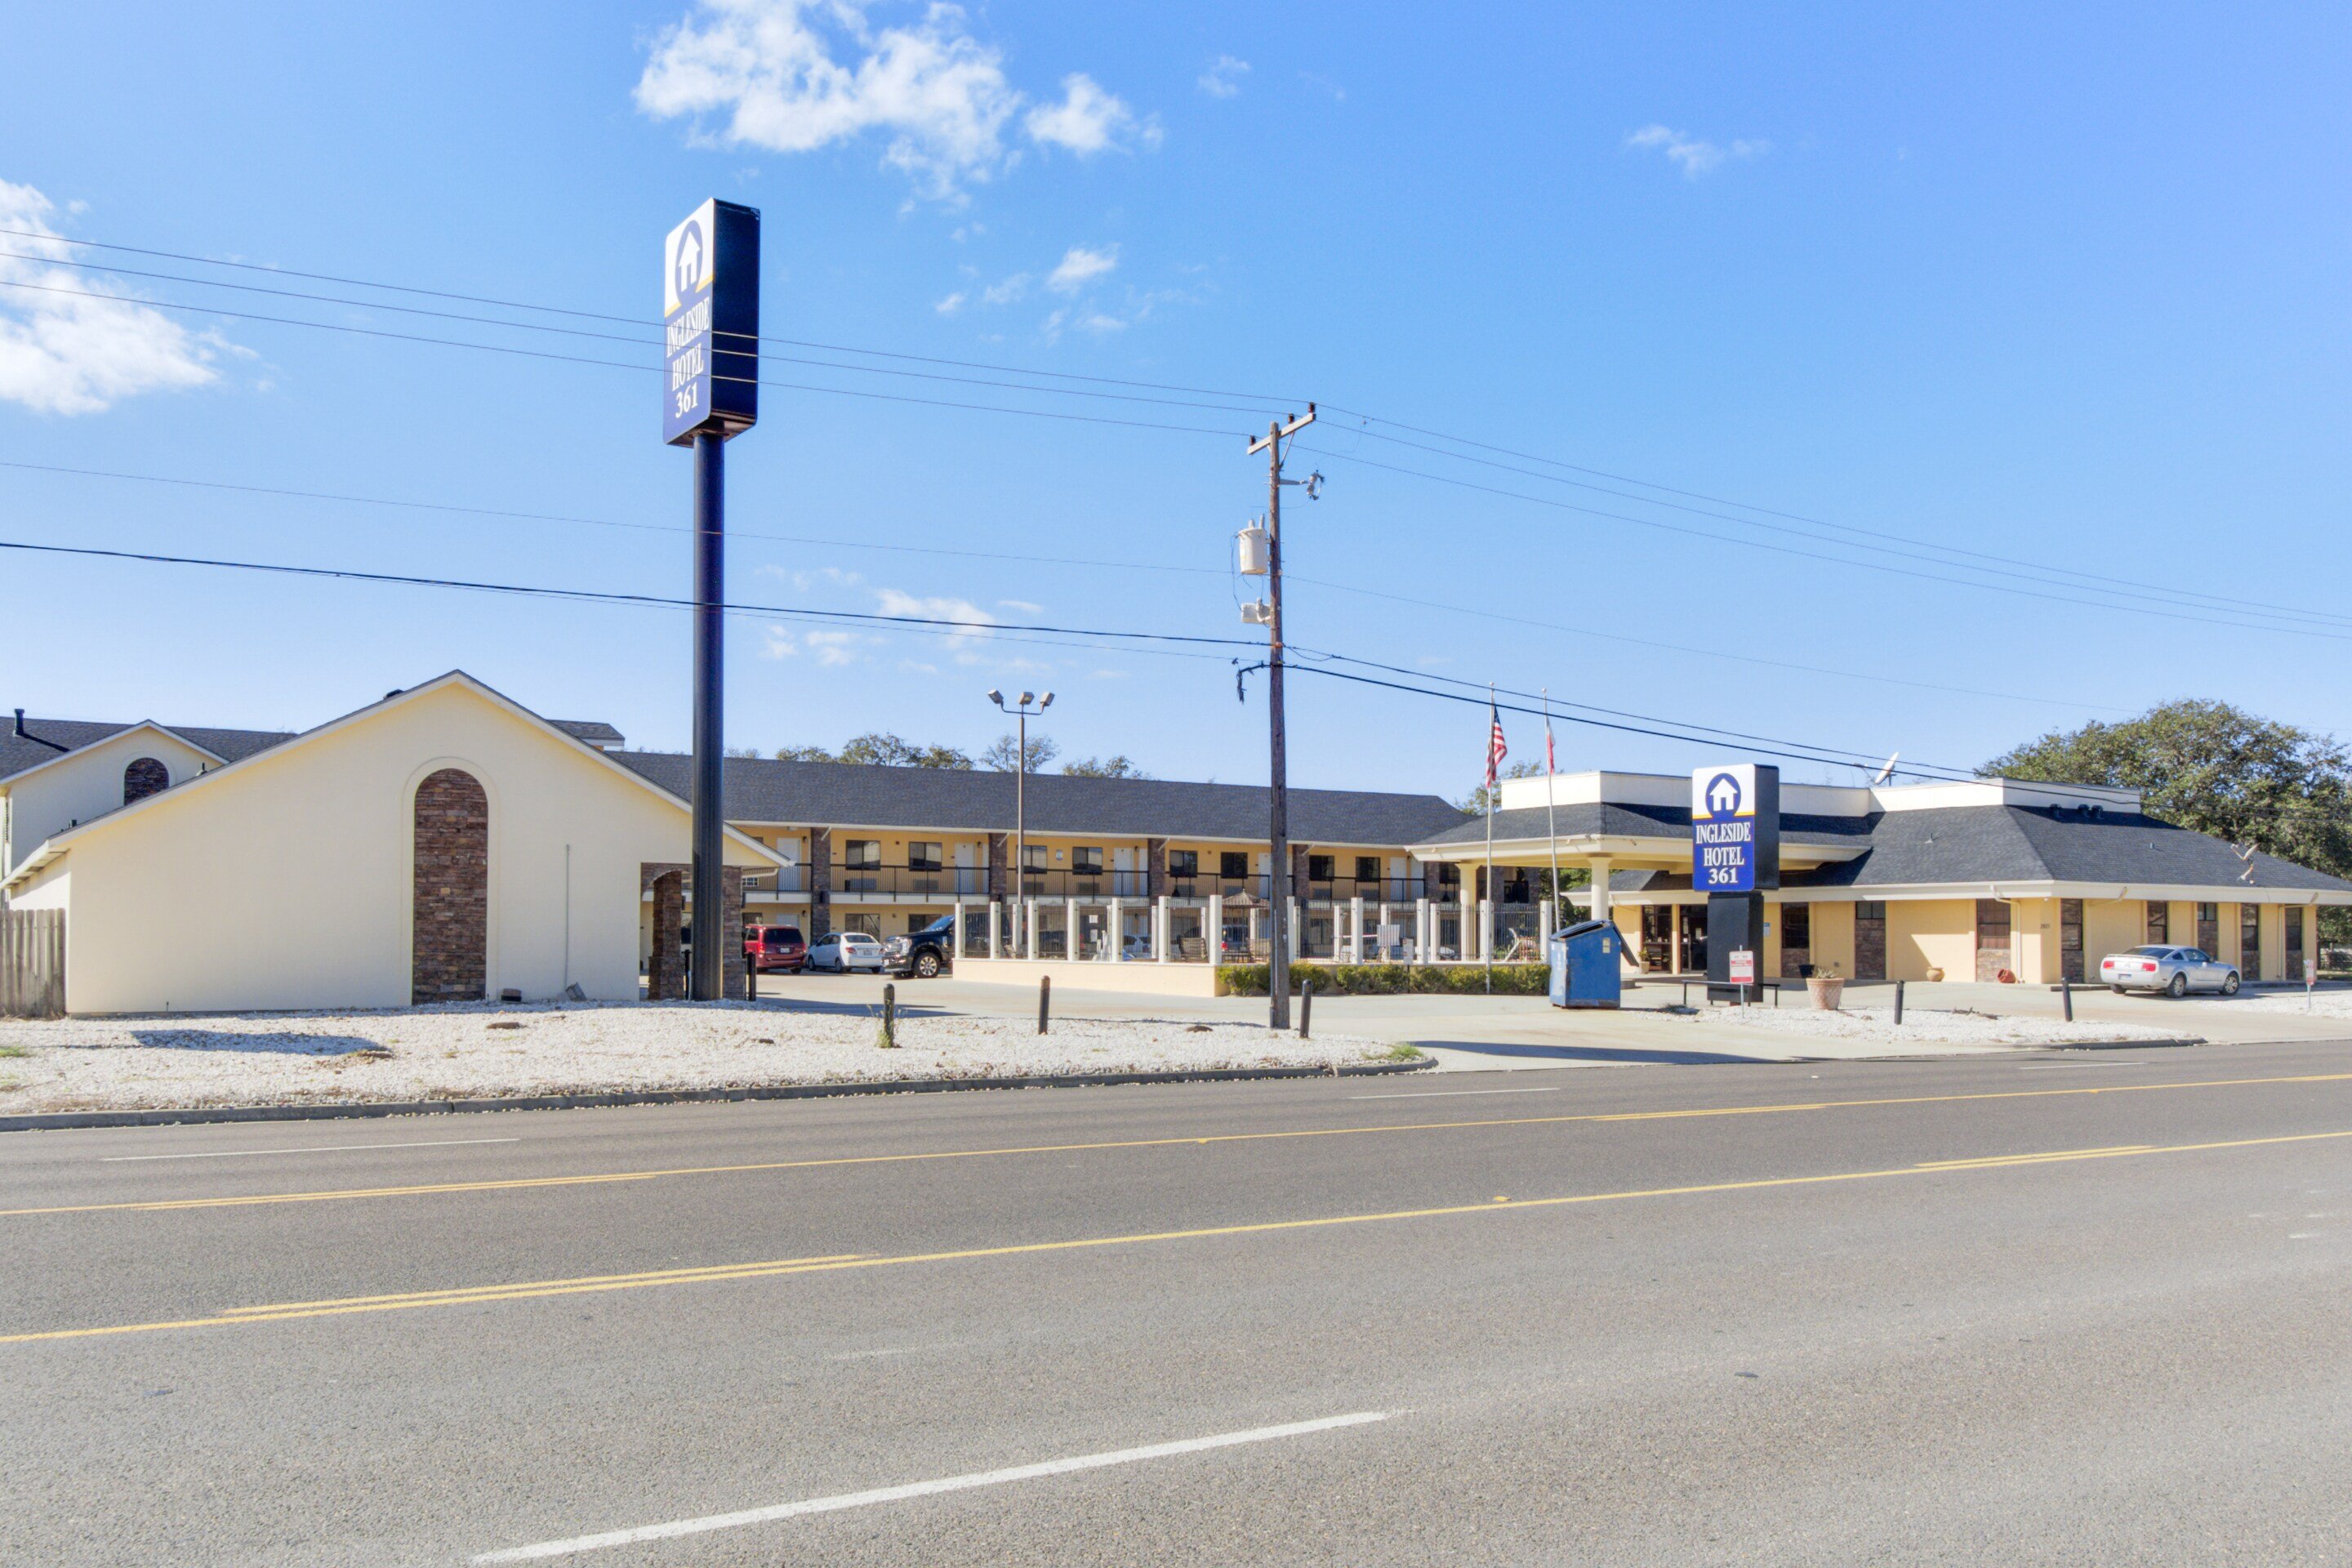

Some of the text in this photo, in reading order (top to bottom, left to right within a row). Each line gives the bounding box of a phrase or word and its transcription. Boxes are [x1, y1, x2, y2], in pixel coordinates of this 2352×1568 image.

[666, 296, 710, 358] INGLESIDE
[672, 343, 703, 391] HOTEL
[675, 382, 698, 418] 361
[1695, 822, 1751, 844] INGLESIDE
[1704, 847, 1744, 866] HOTEL
[1708, 867, 1738, 884] 361
